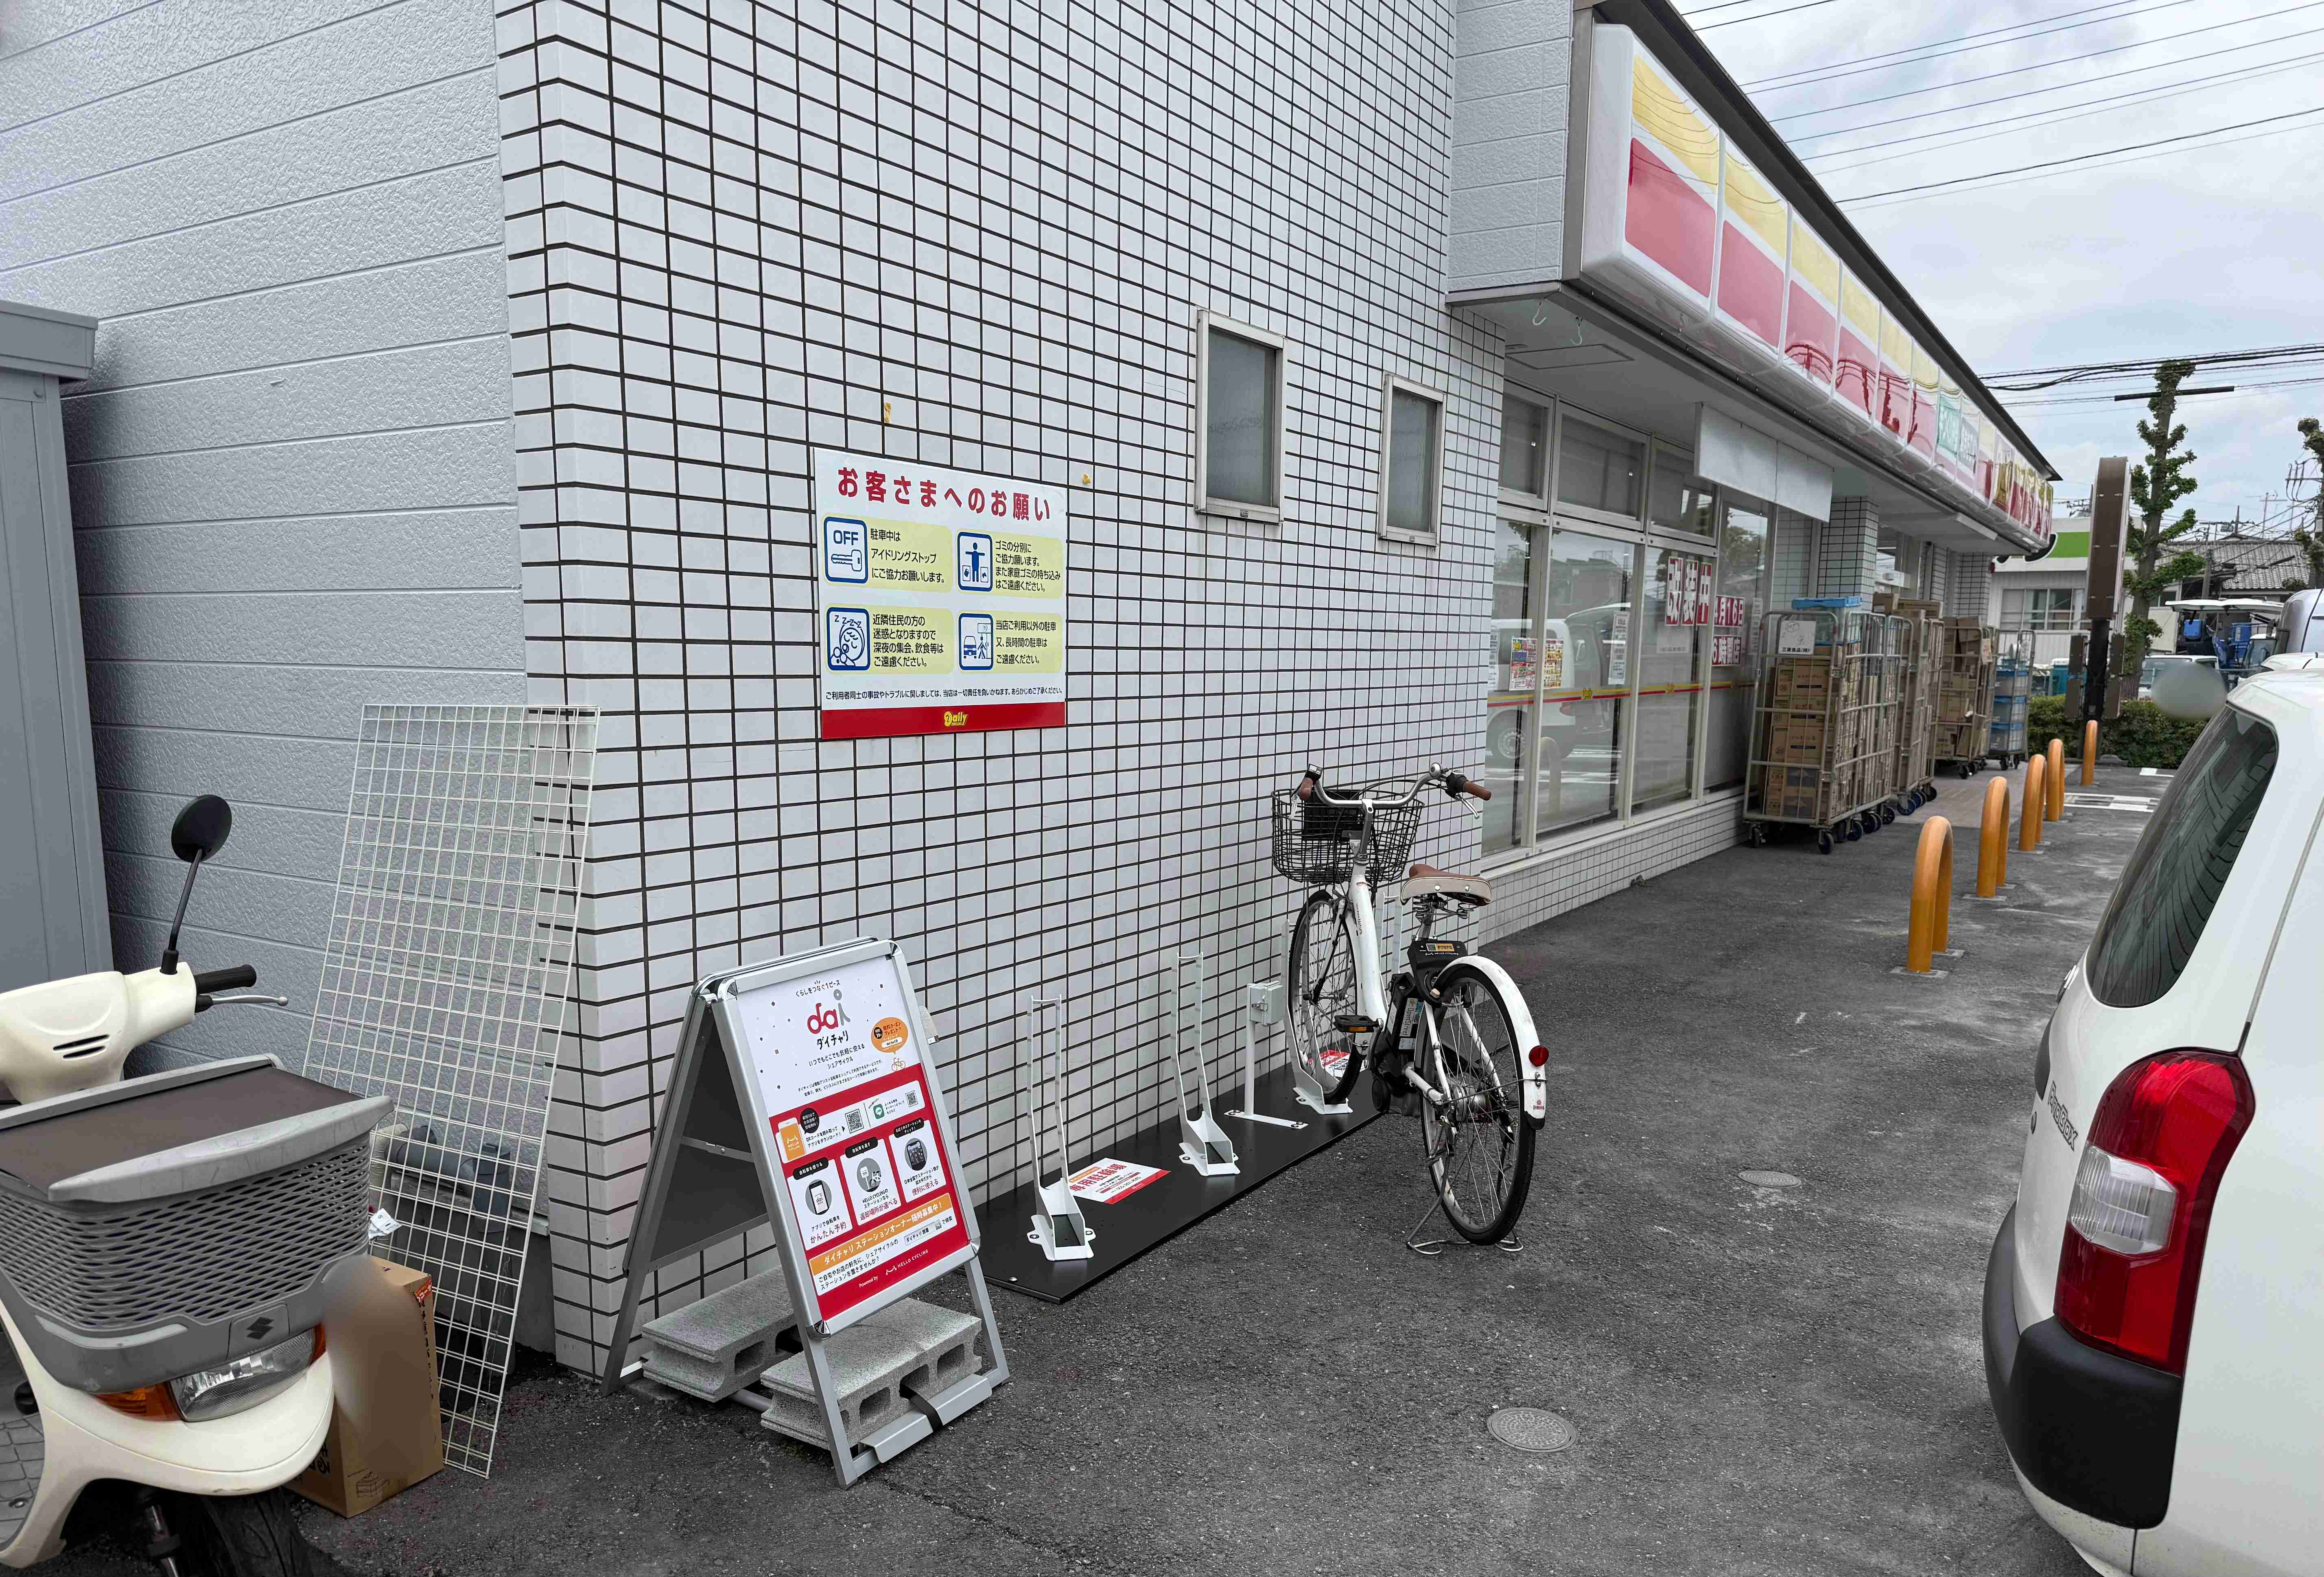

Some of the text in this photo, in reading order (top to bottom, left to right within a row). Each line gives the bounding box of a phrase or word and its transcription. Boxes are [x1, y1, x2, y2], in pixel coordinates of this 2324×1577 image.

[838, 467, 1050, 521] お客さまへのお願い
[833, 530, 859, 545] OFF
[870, 528, 901, 542] 駐車中は
[995, 540, 1032, 553] ゴミの分別に
[871, 548, 936, 564] アイドリングストップ
[995, 553, 1039, 566] ご協力願います。
[872, 567, 944, 583] にご協力お願いします。
[995, 566, 1061, 580] また家庭ゴミの持ち込み
[995, 580, 1045, 592] はご遠慮ください。
[872, 614, 925, 626] 近隣住民の方の
[996, 620, 1057, 631] 当店ご利用以外の駐車
[873, 628, 936, 640] 迷惑となりますので
[873, 642, 944, 654] 深夜の集会、飲食等は
[996, 637, 1047, 647] 又、長時間の駐車は
[874, 656, 927, 667] ご遠慮ください。
[996, 654, 1040, 664] ご遠慮ください。
[944, 711, 969, 727] Daily
[796, 980, 841, 997] くらしをつなぐ1ピース
[807, 989, 851, 1034] dai
[817, 1030, 849, 1050] ダイチャリ
[809, 1043, 865, 1067] いつでもどこでも気軽に使える
[827, 1056, 853, 1069] シェアサイクル
[1069, 1164, 1127, 1192] 専用駐輪場
[912, 1179, 938, 1196] 便利に使える
[860, 1199, 897, 1220] 返却場所が選べる
[864, 1195, 889, 1209] ステーションなら
[811, 1215, 840, 1232] アプリで自転車を
[810, 1221, 847, 1244] かんたん予約
[824, 1245, 853, 1266] ダイチャリ
[897, 1249, 929, 1268] HELLO CYCLING
[820, 1256, 879, 1290] ステーションを置きませんか?
[859, 1278, 874, 1288] Powered
